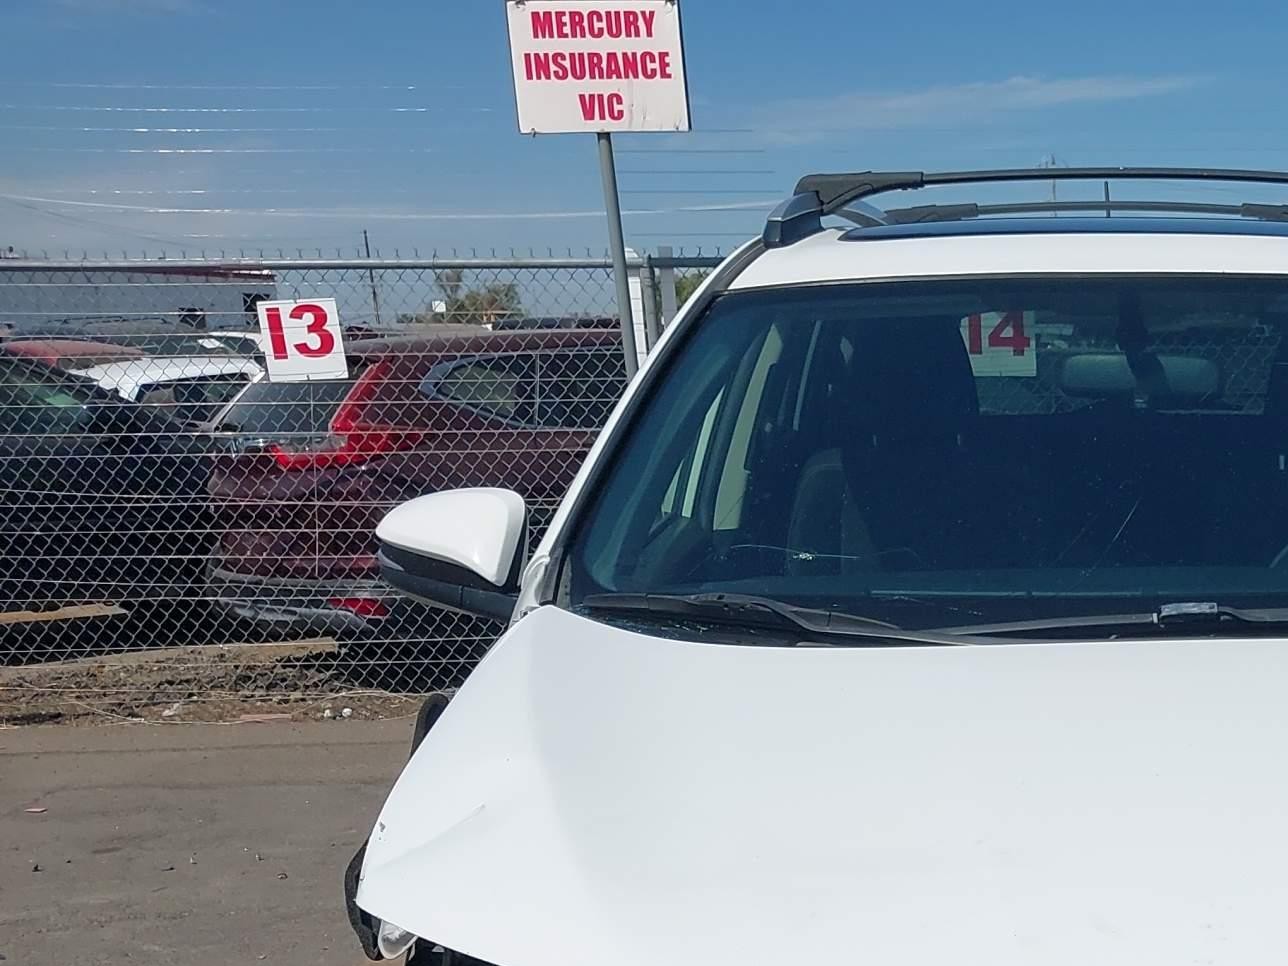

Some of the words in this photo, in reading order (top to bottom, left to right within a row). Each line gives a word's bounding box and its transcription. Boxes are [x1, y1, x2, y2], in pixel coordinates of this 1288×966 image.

[531, 10, 656, 39] MERCURY
[524, 52, 672, 80] INSURANCE
[578, 93, 624, 121] VIC
[265, 304, 335, 360] 13
[968, 309, 1031, 356] 14
